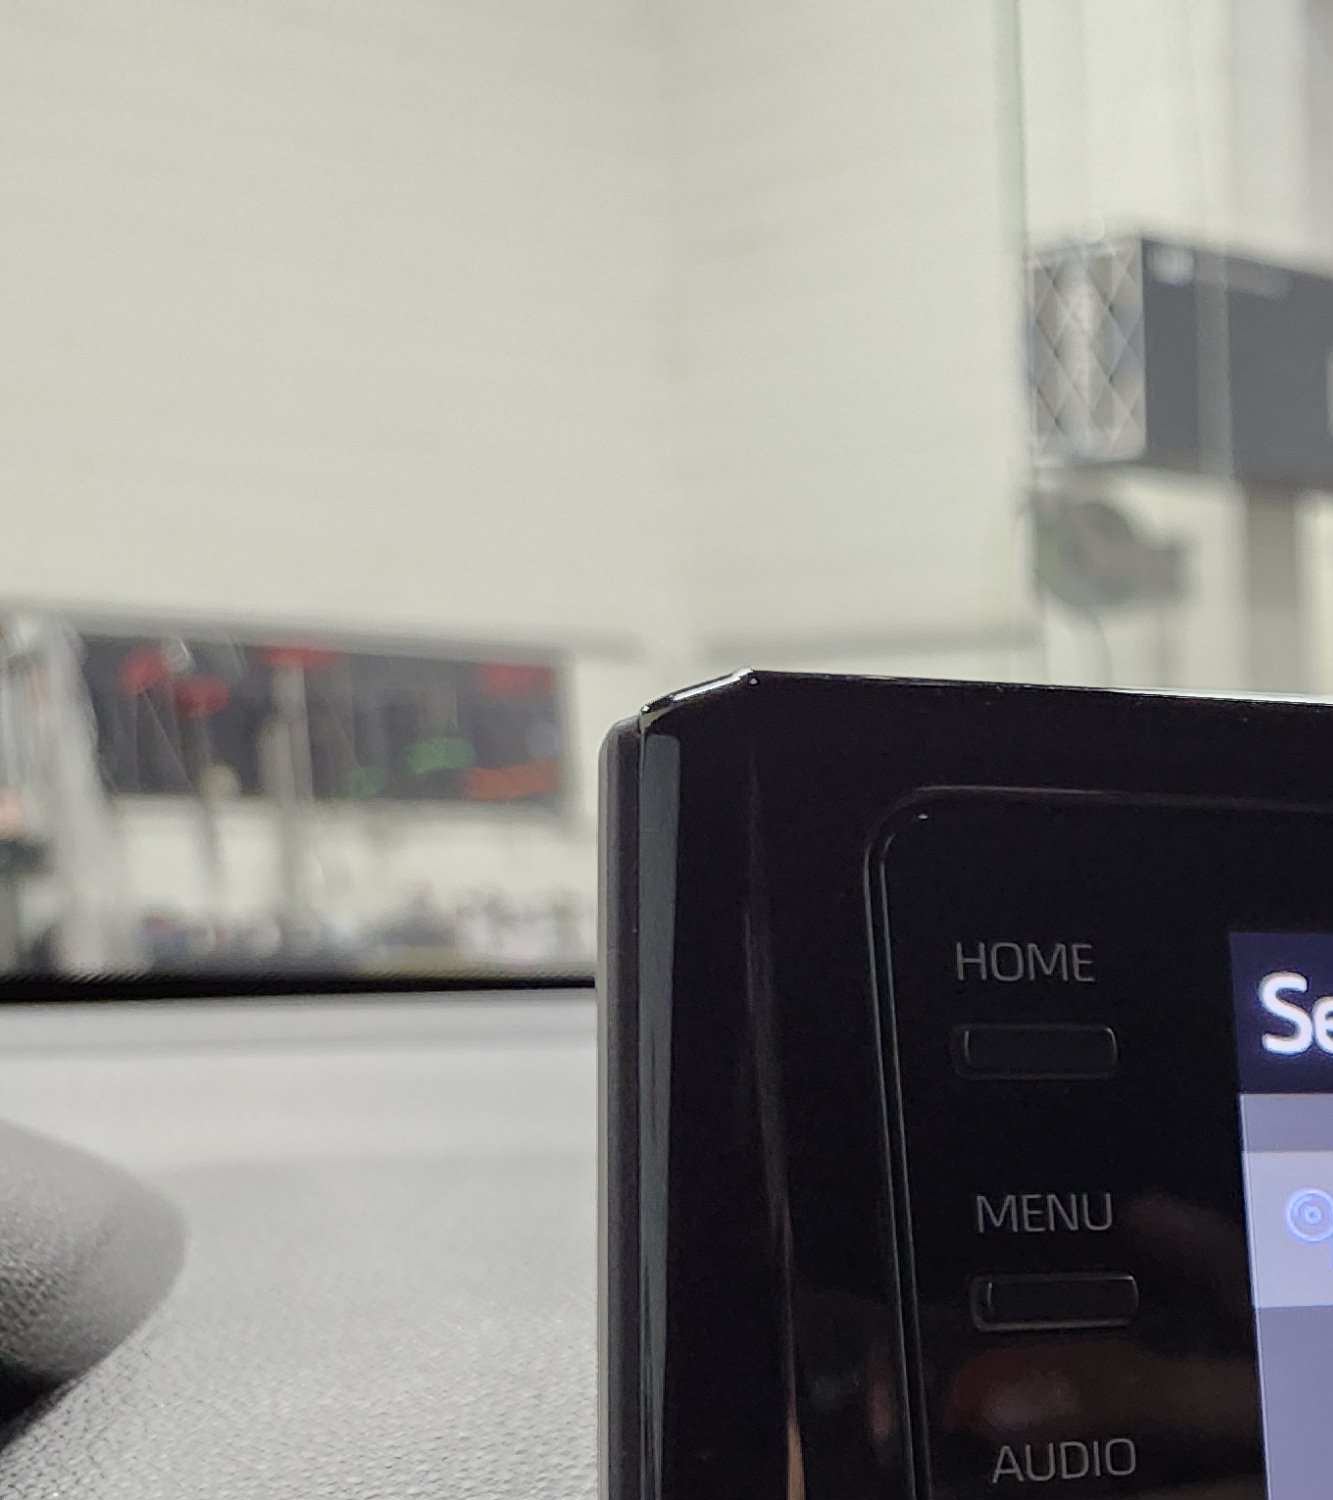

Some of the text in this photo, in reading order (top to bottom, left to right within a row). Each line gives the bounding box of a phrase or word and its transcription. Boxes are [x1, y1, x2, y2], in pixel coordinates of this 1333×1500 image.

[957, 941, 1096, 982] HOME
[977, 1193, 1113, 1234] MENU
[992, 1437, 1138, 1484] AUDIO
